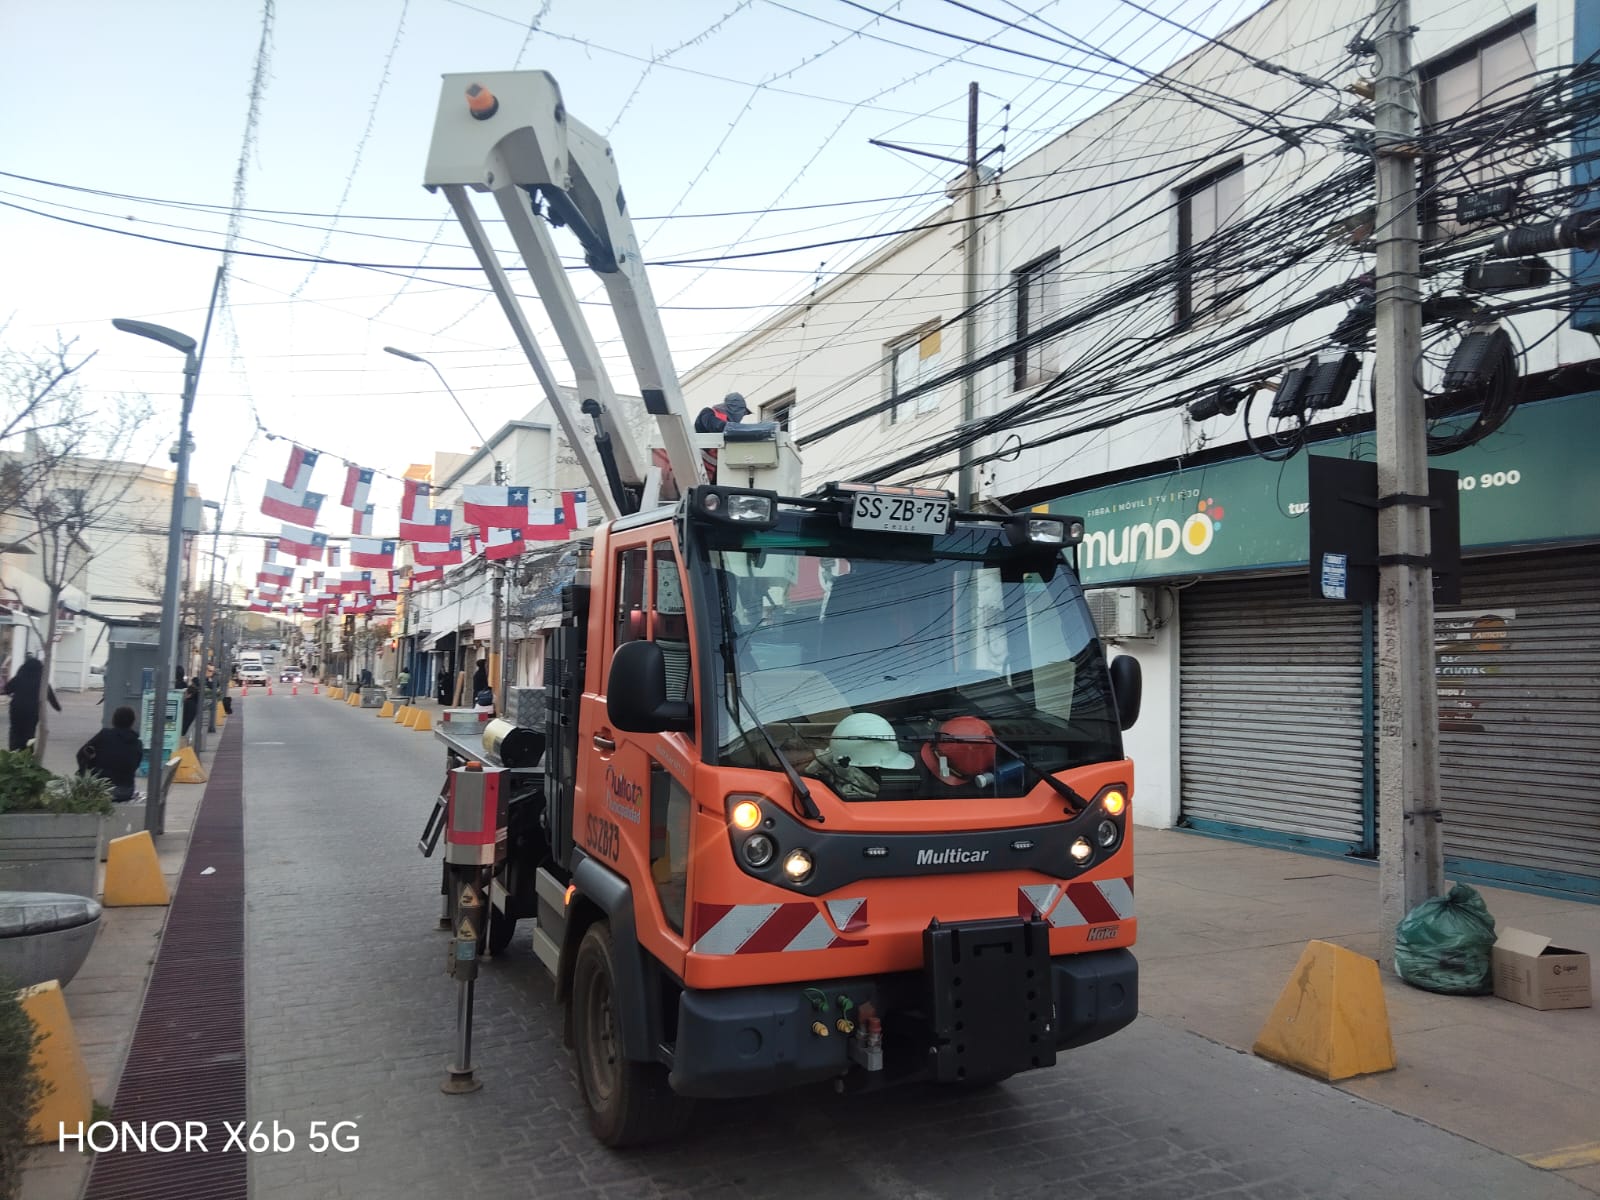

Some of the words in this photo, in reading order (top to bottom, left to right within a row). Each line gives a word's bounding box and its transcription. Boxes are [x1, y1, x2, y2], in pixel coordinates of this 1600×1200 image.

[1480, 470, 1521, 488] 900
[1087, 508, 1111, 517] FIBRA
[916, 848, 989, 866] Multicar
[1087, 926, 1120, 941] Hako
